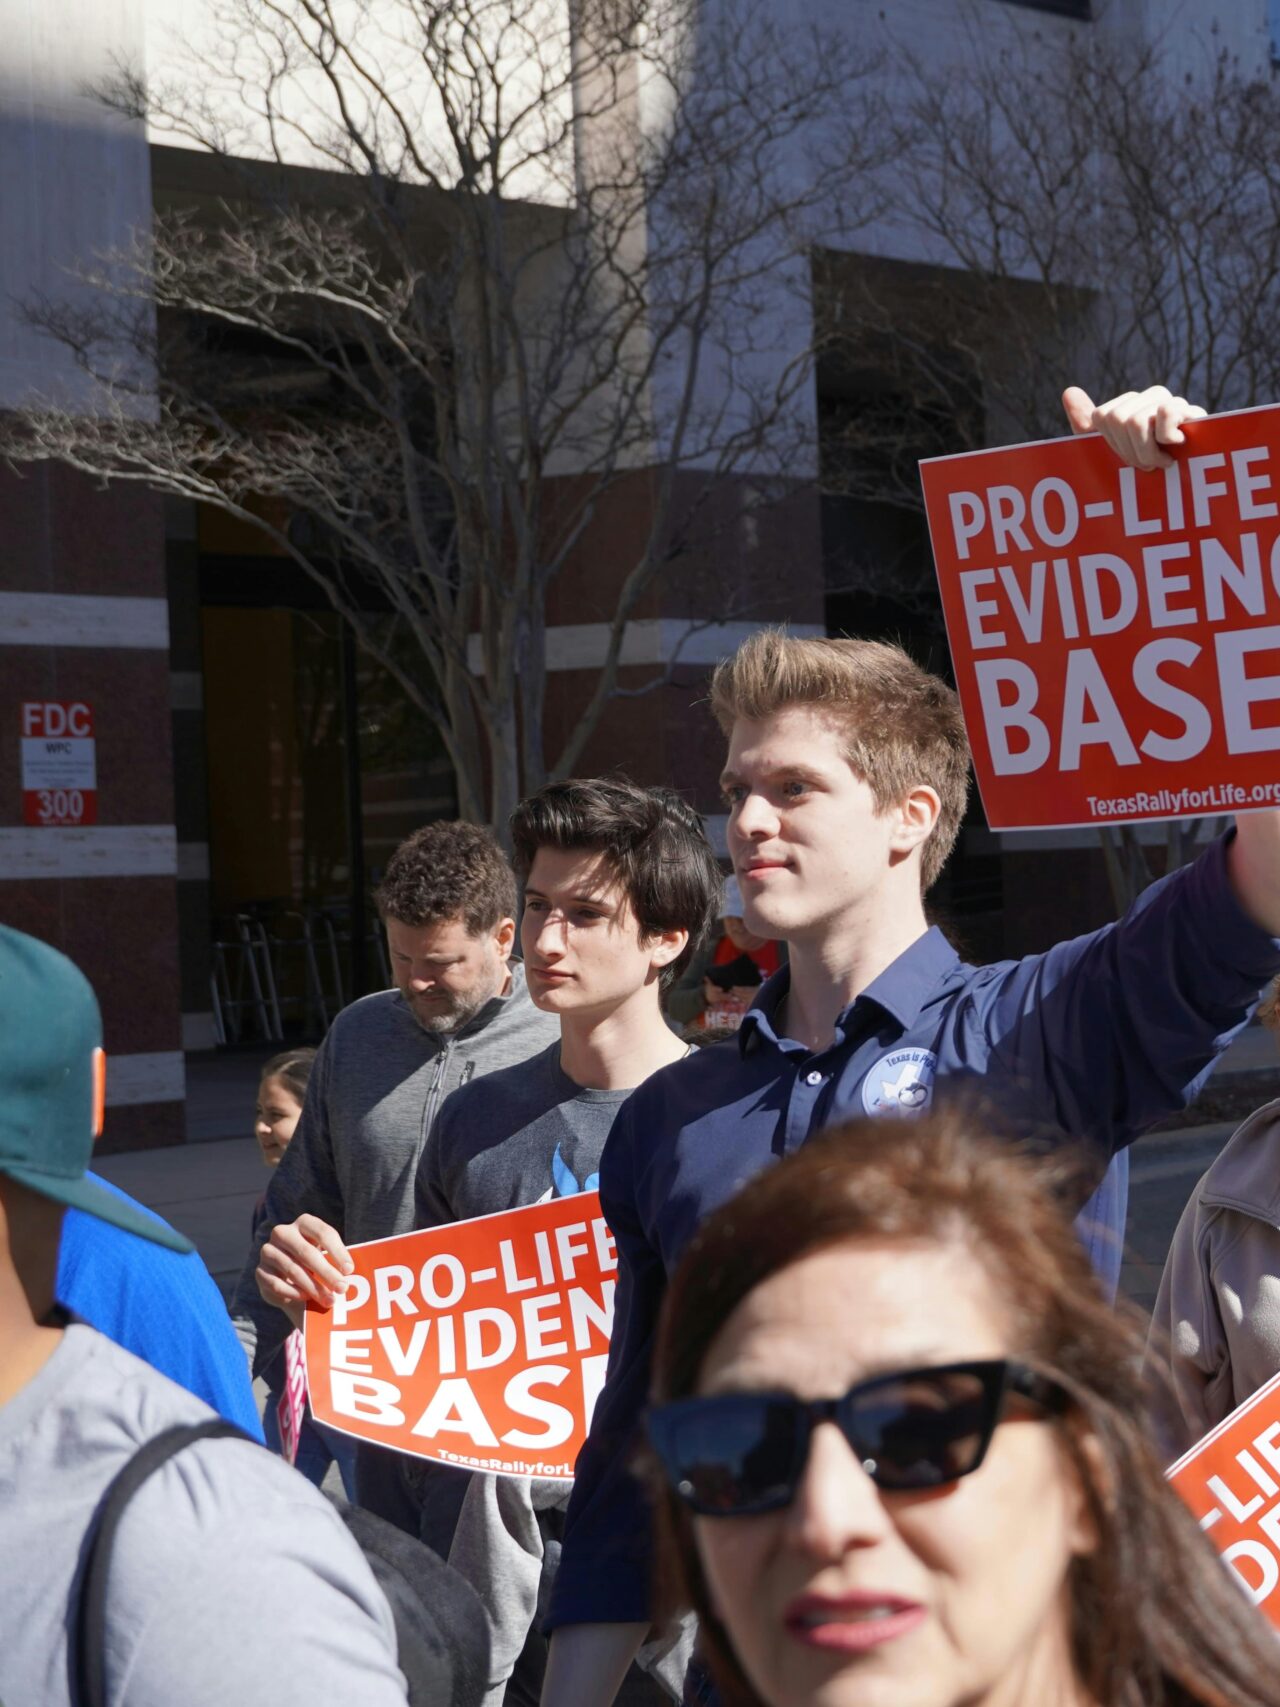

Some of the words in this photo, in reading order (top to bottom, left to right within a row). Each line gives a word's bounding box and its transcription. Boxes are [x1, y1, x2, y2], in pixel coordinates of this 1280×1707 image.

[948, 446, 1279, 560] PRO-LIFE
[23, 703, 91, 736] FDC
[46, 743, 72, 754] WPC
[38, 789, 84, 818] 300
[332, 1216, 618, 1326] PRO-LIFE
